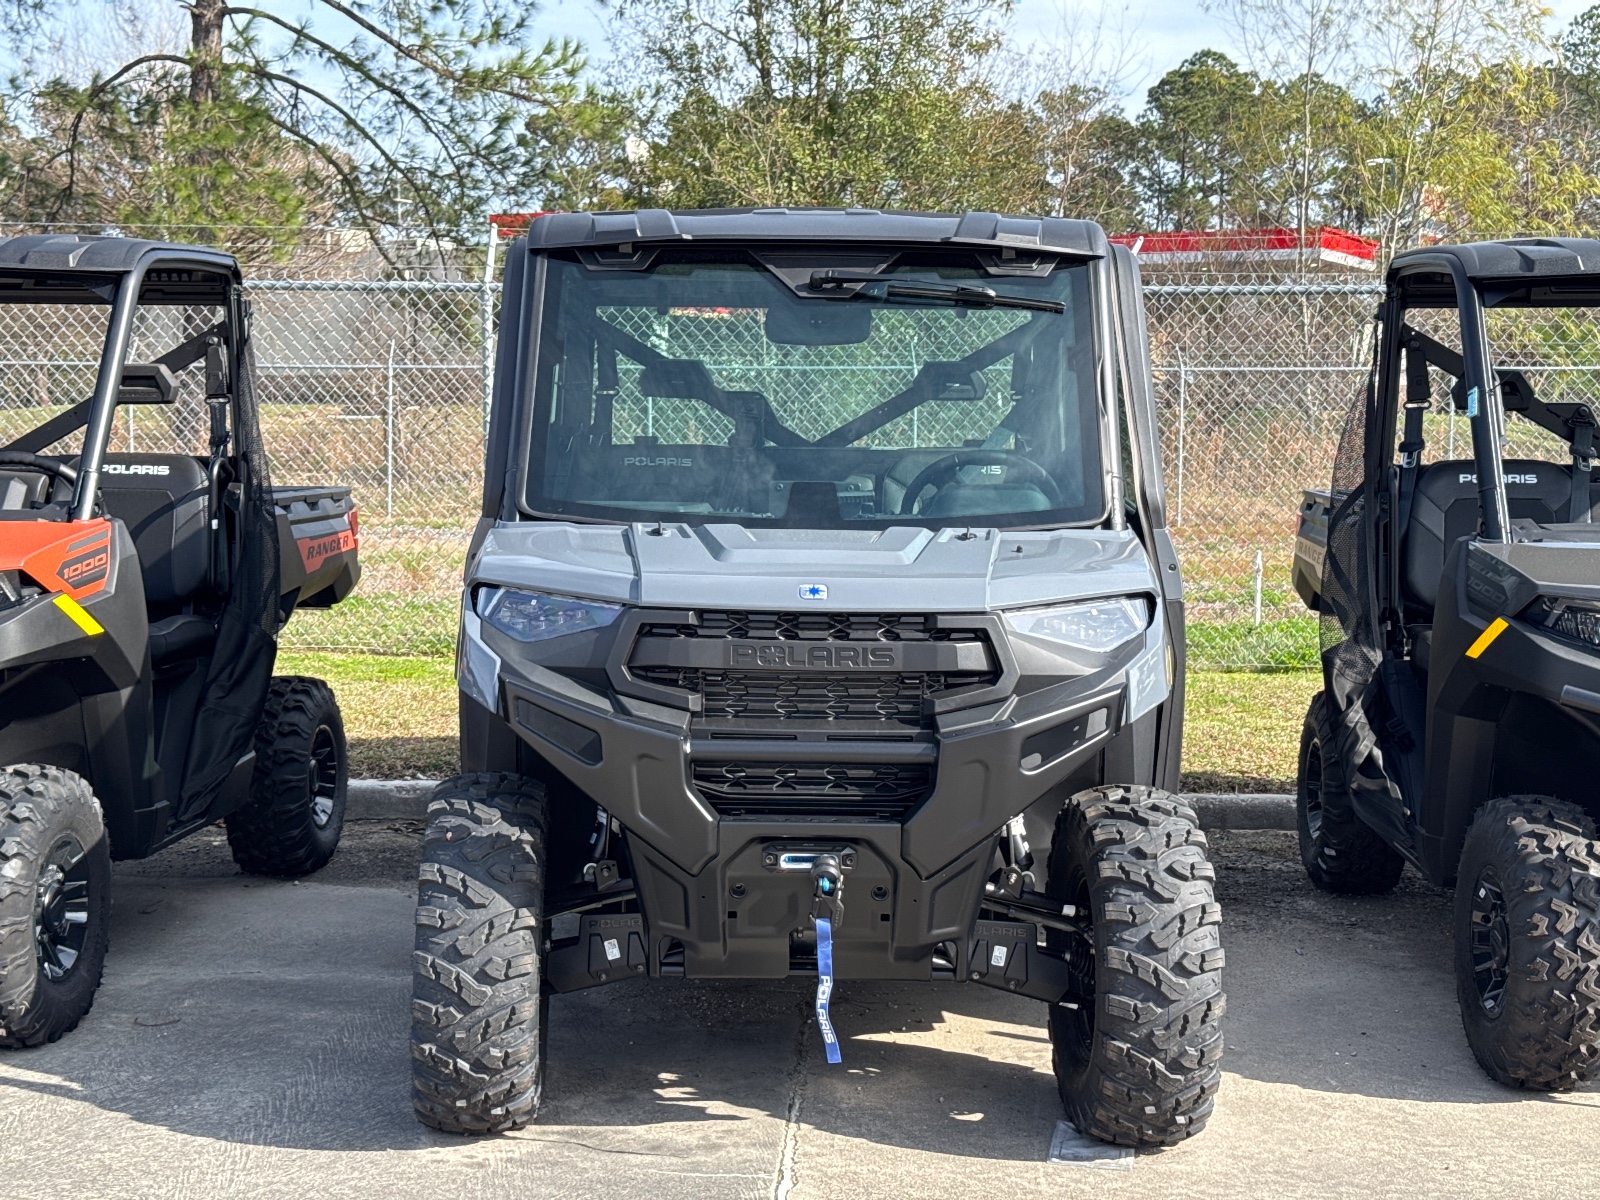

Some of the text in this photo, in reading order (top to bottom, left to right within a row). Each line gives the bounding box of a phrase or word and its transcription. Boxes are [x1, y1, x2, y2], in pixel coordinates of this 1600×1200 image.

[624, 457, 692, 466] POLARIS
[307, 535, 349, 560] RANGER
[1299, 541, 1323, 566] RANGE
[64, 553, 107, 579] 1000
[731, 645, 895, 668] POLARIS
[817, 975, 835, 1044] POLARIS
